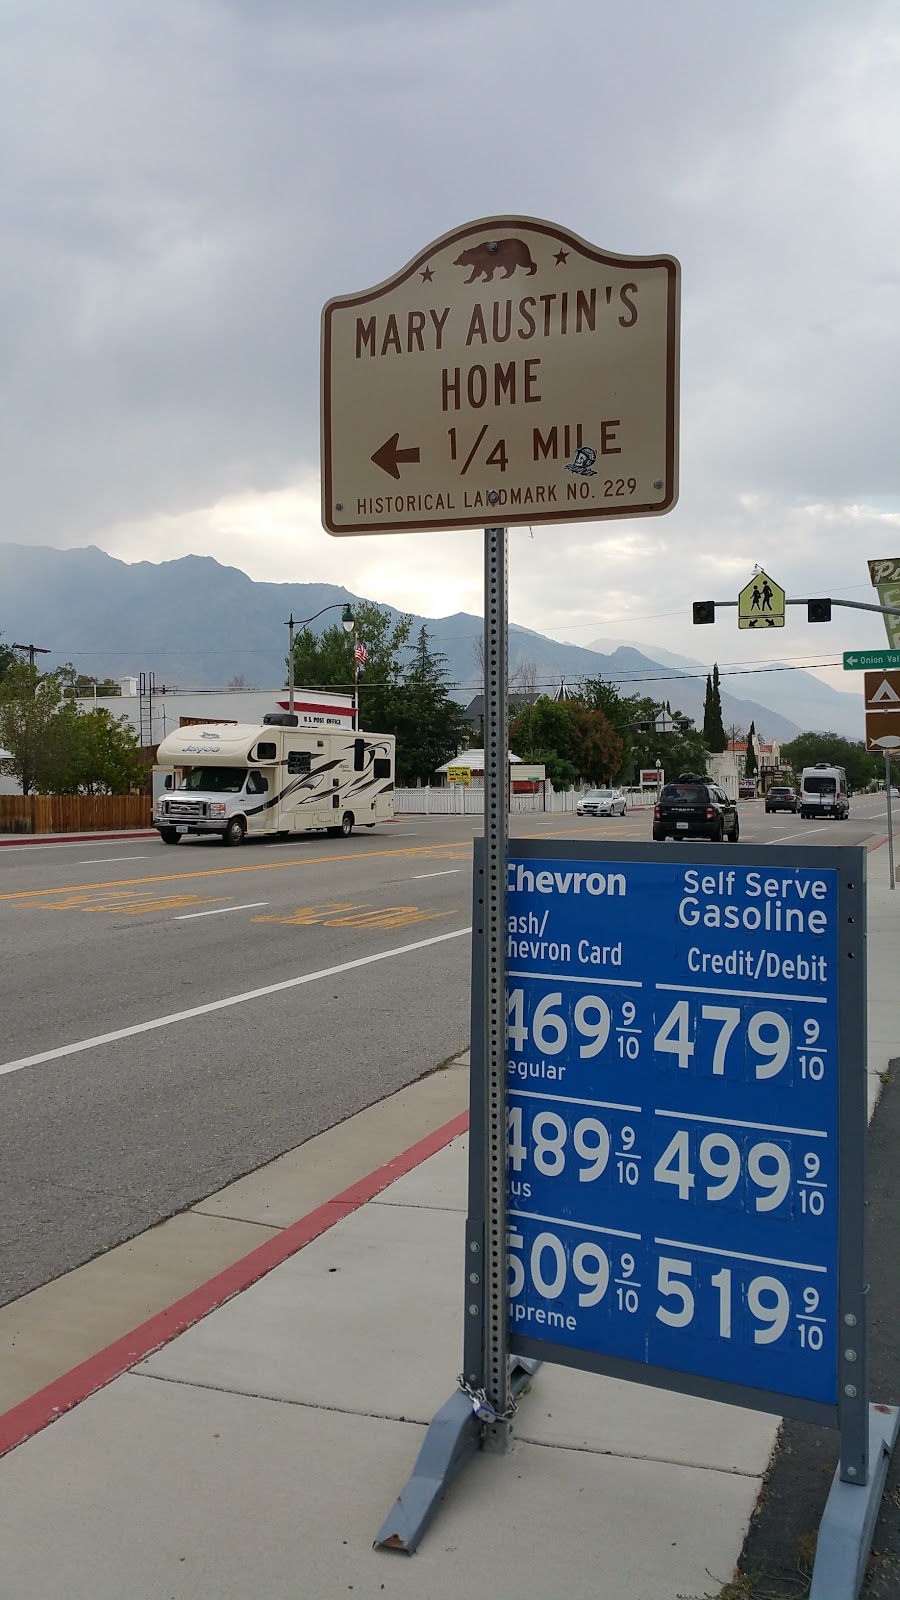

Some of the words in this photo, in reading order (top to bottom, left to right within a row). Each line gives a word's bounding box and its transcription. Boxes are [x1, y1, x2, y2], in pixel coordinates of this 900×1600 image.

[355, 307, 451, 359] MARY
[465, 282, 639, 346] AUSTIN'S
[441, 358, 542, 411] HOME
[448, 424, 509, 476] 1/4
[533, 419, 622, 461] MILE
[357, 493, 456, 515] HISTORICAL
[566, 482, 595, 500] NO.
[603, 477, 637, 498] 229
[860, 655, 883, 664] Onion
[887, 654, 900, 663] Val
[182, 744, 221, 754] Jayco
[683, 869, 735, 895] Self
[745, 872, 827, 900] Serve
[506, 910, 549, 941] ash/
[679, 895, 827, 934] Gasoline
[507, 937, 571, 962] hevron
[578, 939, 622, 966] Card
[687, 947, 827, 982] Credit/Debit
[653, 1000, 791, 1080] 479
[507, 1060, 566, 1081] egular
[653, 1130, 791, 1212] 499
[506, 1181, 532, 1198] us
[509, 1303, 578, 1331] preme
[655, 1256, 791, 1345] 519
